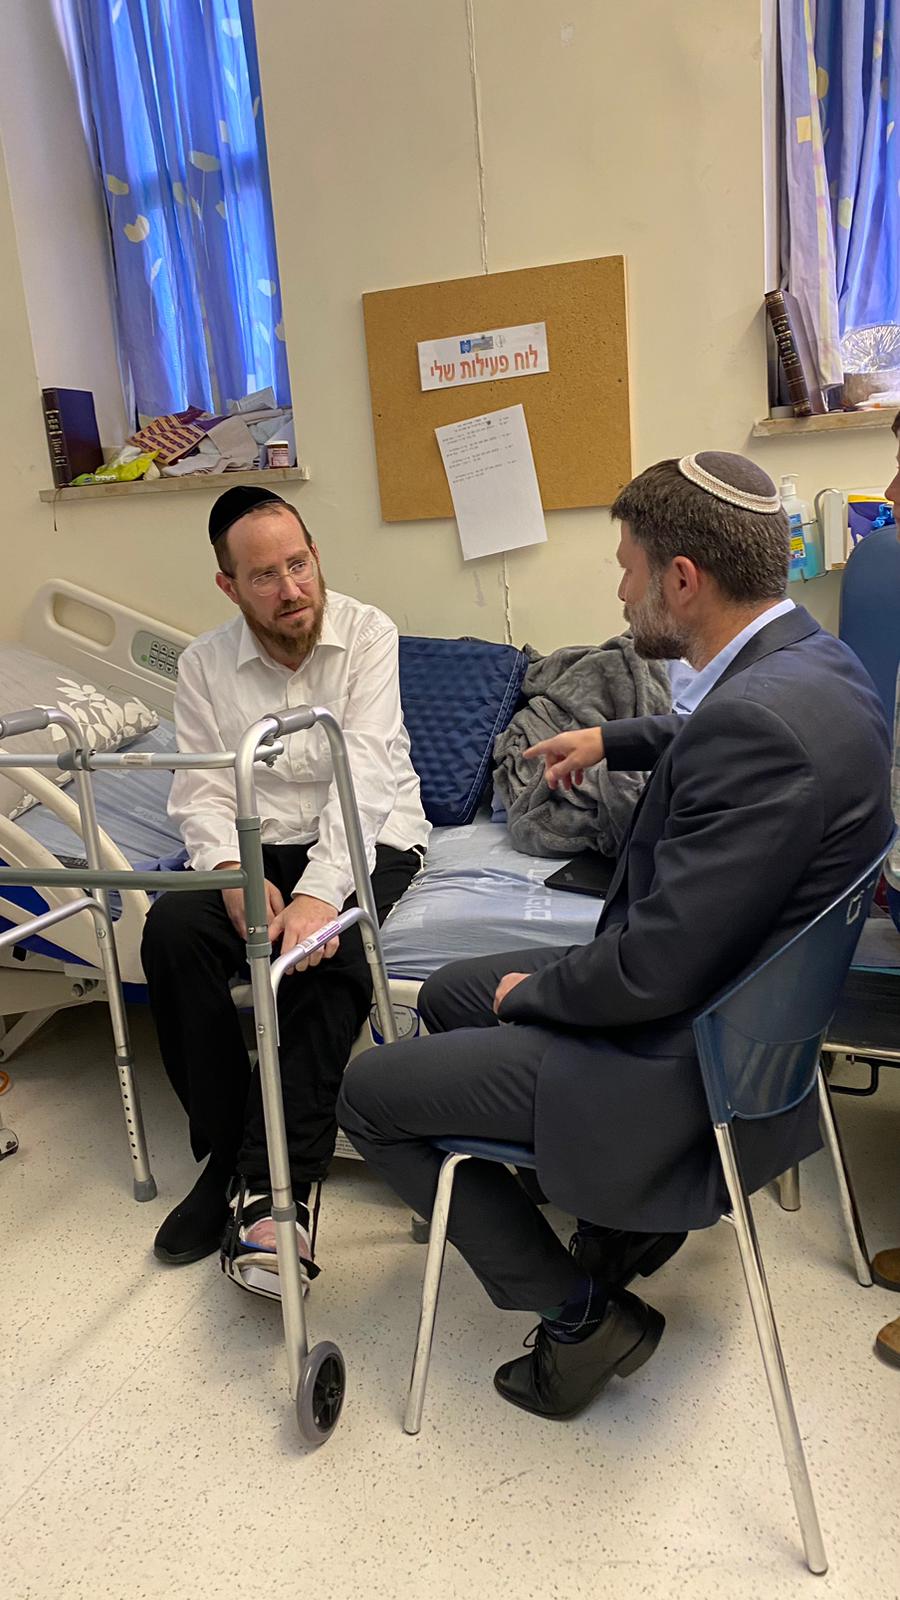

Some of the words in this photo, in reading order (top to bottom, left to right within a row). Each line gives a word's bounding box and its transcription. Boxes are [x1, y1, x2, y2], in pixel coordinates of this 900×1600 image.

[460, 353, 510, 379] פעילות
[514, 344, 538, 371] לוח
[430, 360, 456, 383] שלי
